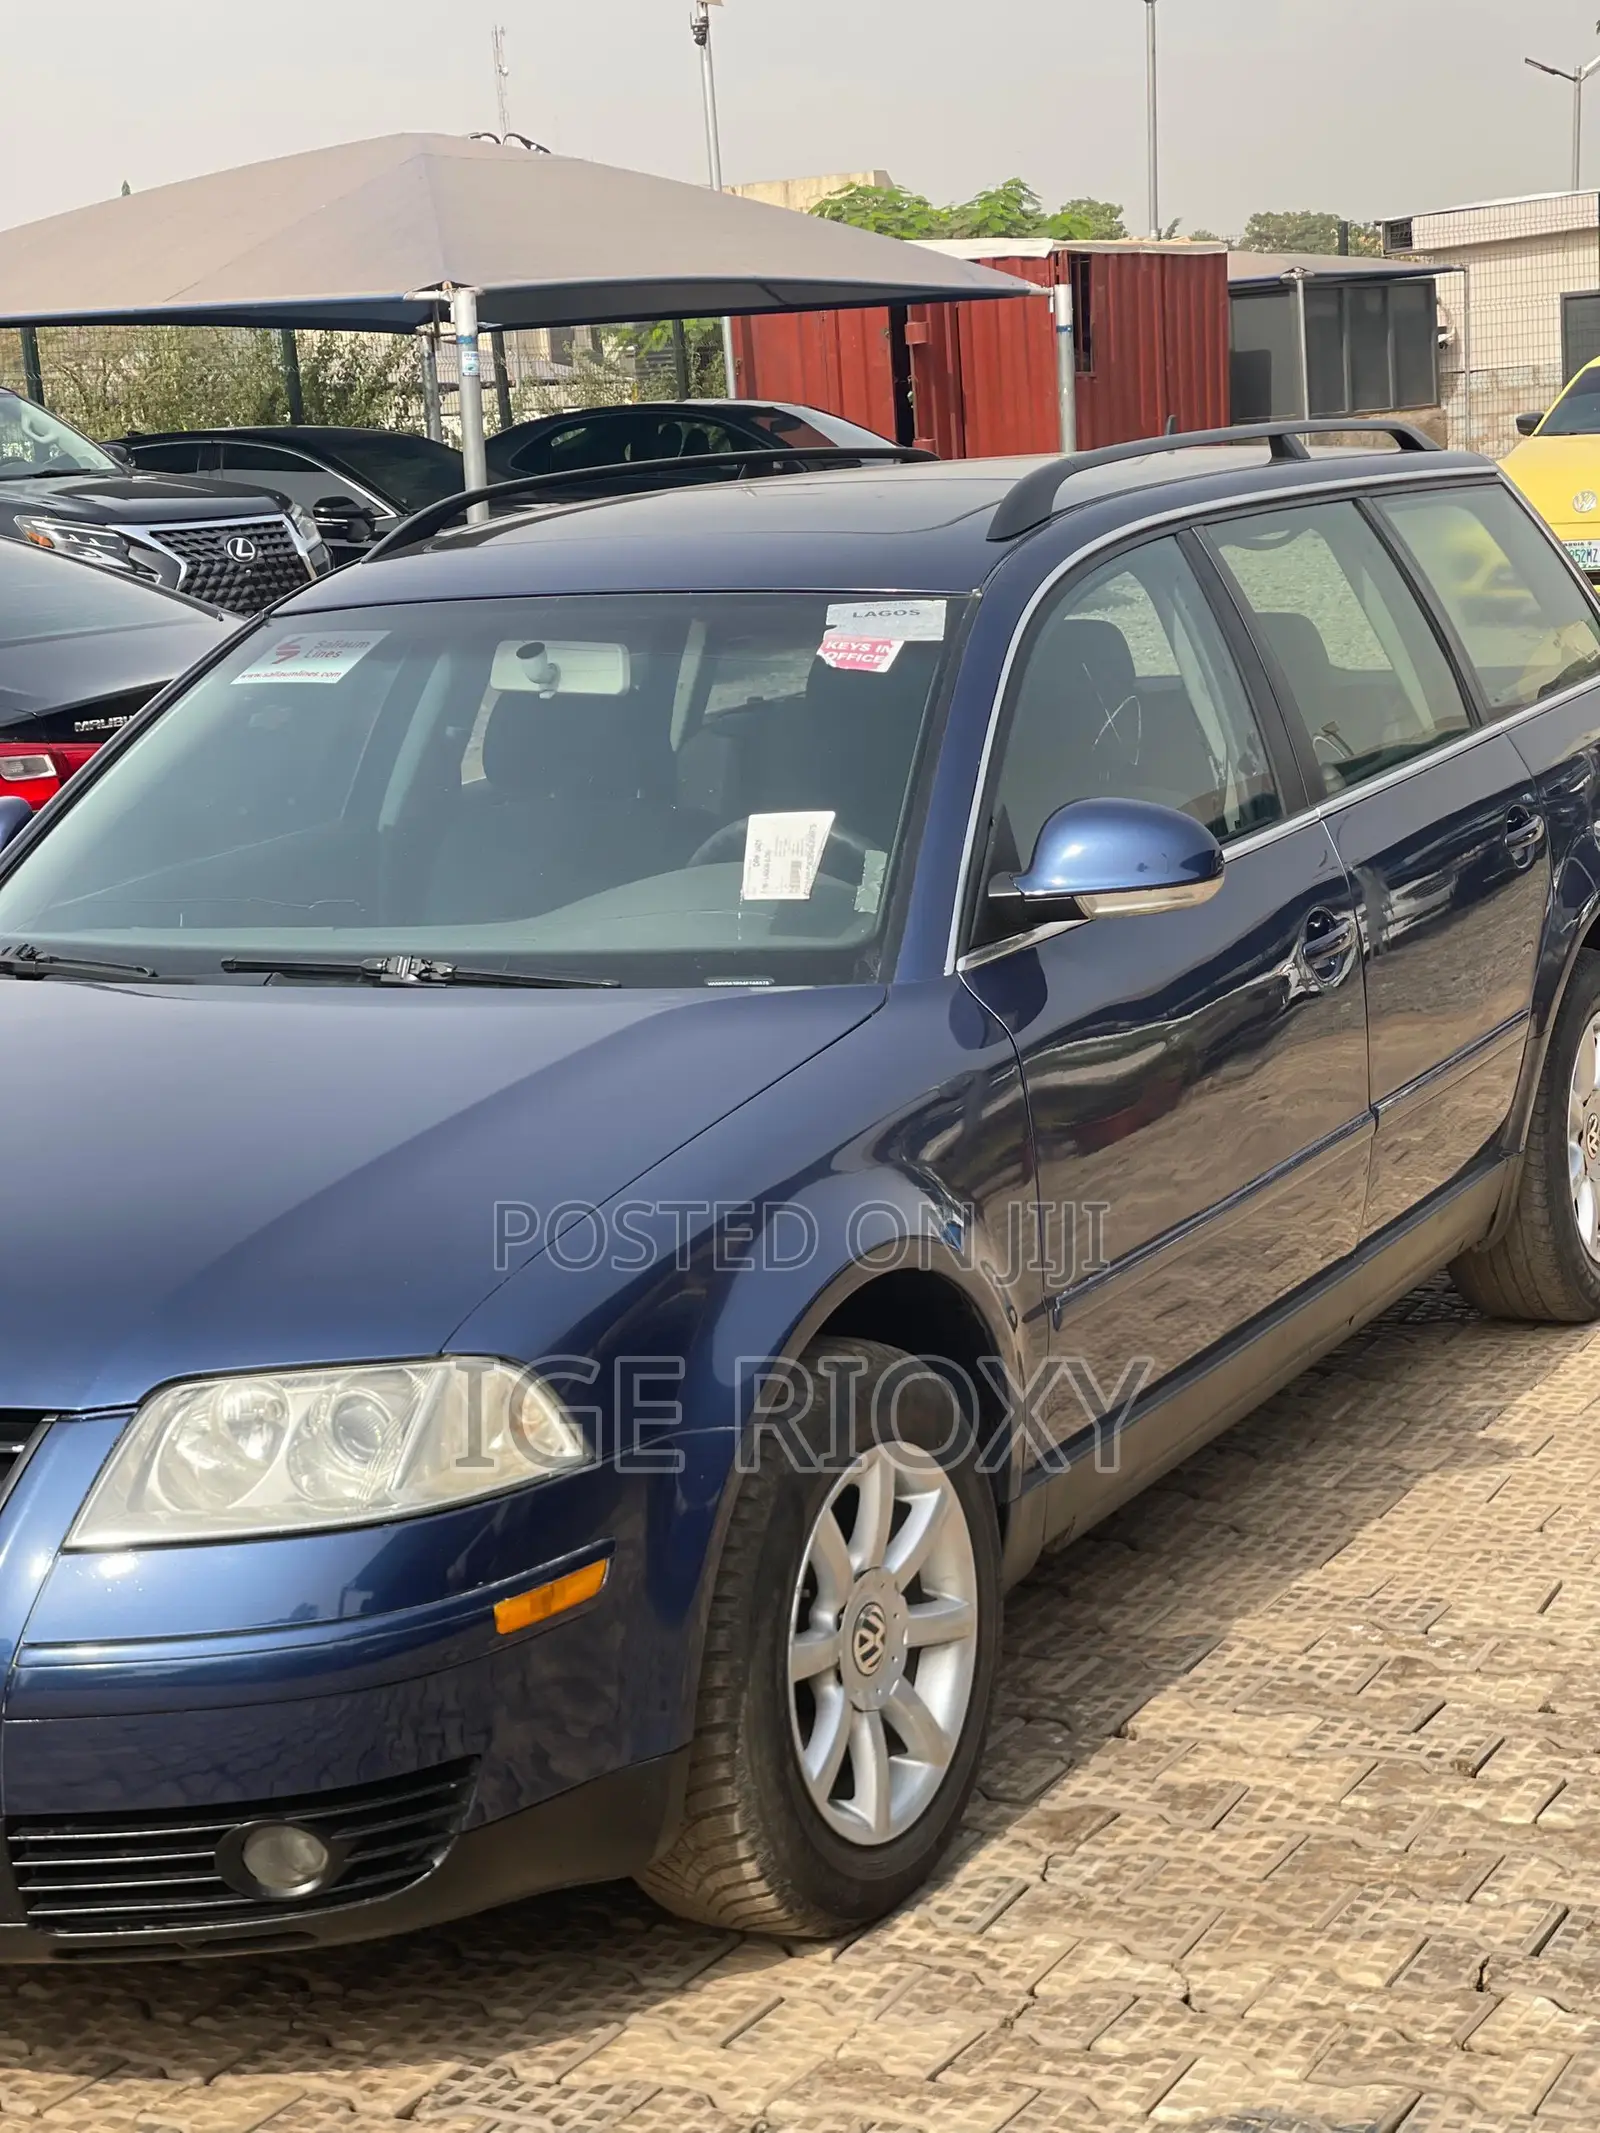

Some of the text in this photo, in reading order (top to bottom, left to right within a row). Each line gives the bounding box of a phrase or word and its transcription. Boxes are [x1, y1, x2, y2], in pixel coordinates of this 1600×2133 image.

[852, 609, 921, 618] LAGOS
[825, 641, 892, 653] KEYS IN
[304, 650, 343, 659] Lines
[824, 651, 884, 663] OFFICE
